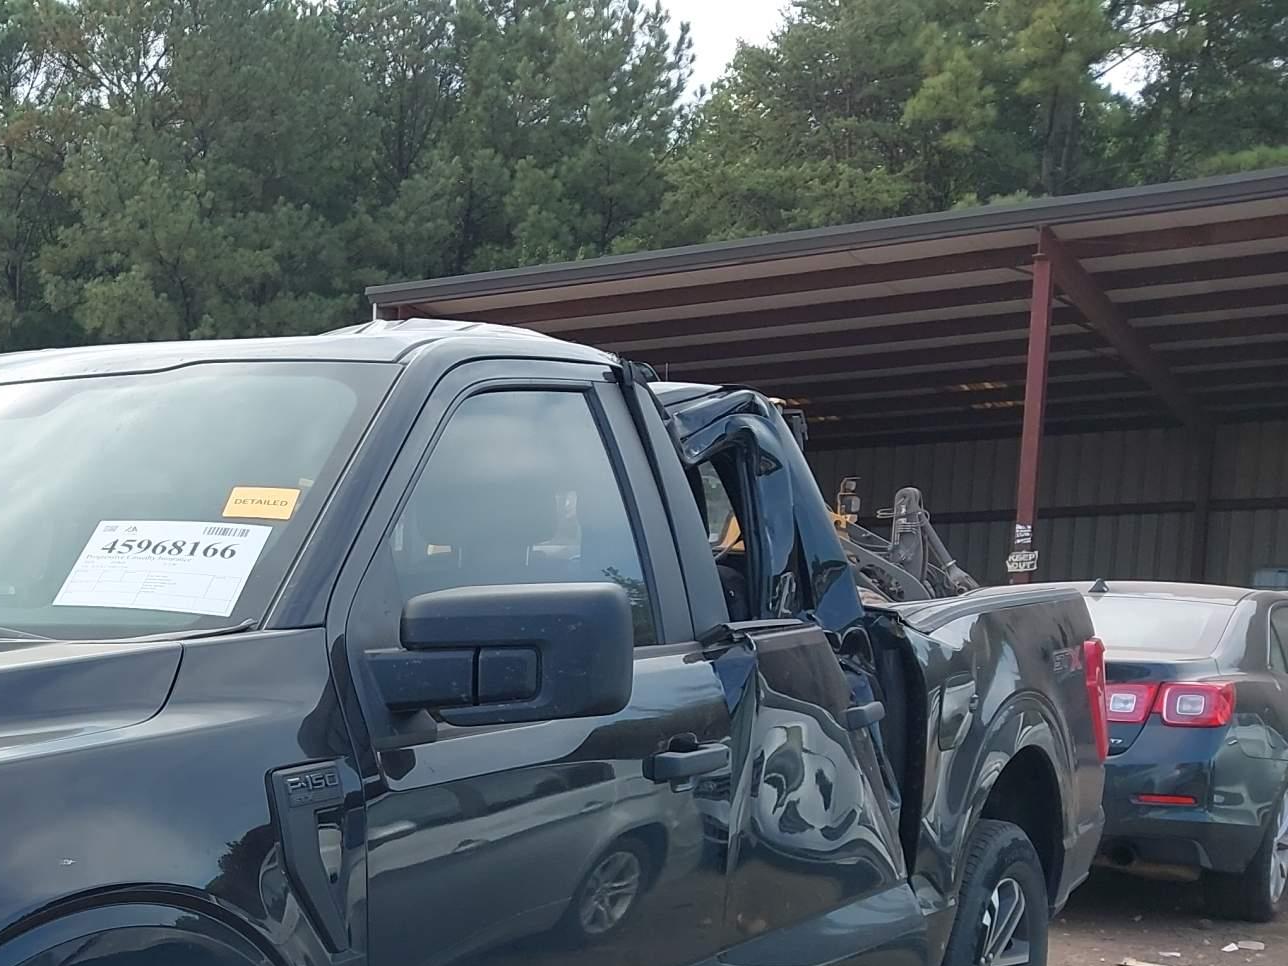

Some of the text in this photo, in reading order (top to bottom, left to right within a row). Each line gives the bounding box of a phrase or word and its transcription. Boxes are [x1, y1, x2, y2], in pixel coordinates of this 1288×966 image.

[234, 498, 289, 507] DETAILED
[101, 538, 240, 560] 45968166
[1011, 561, 1034, 569] OUT
